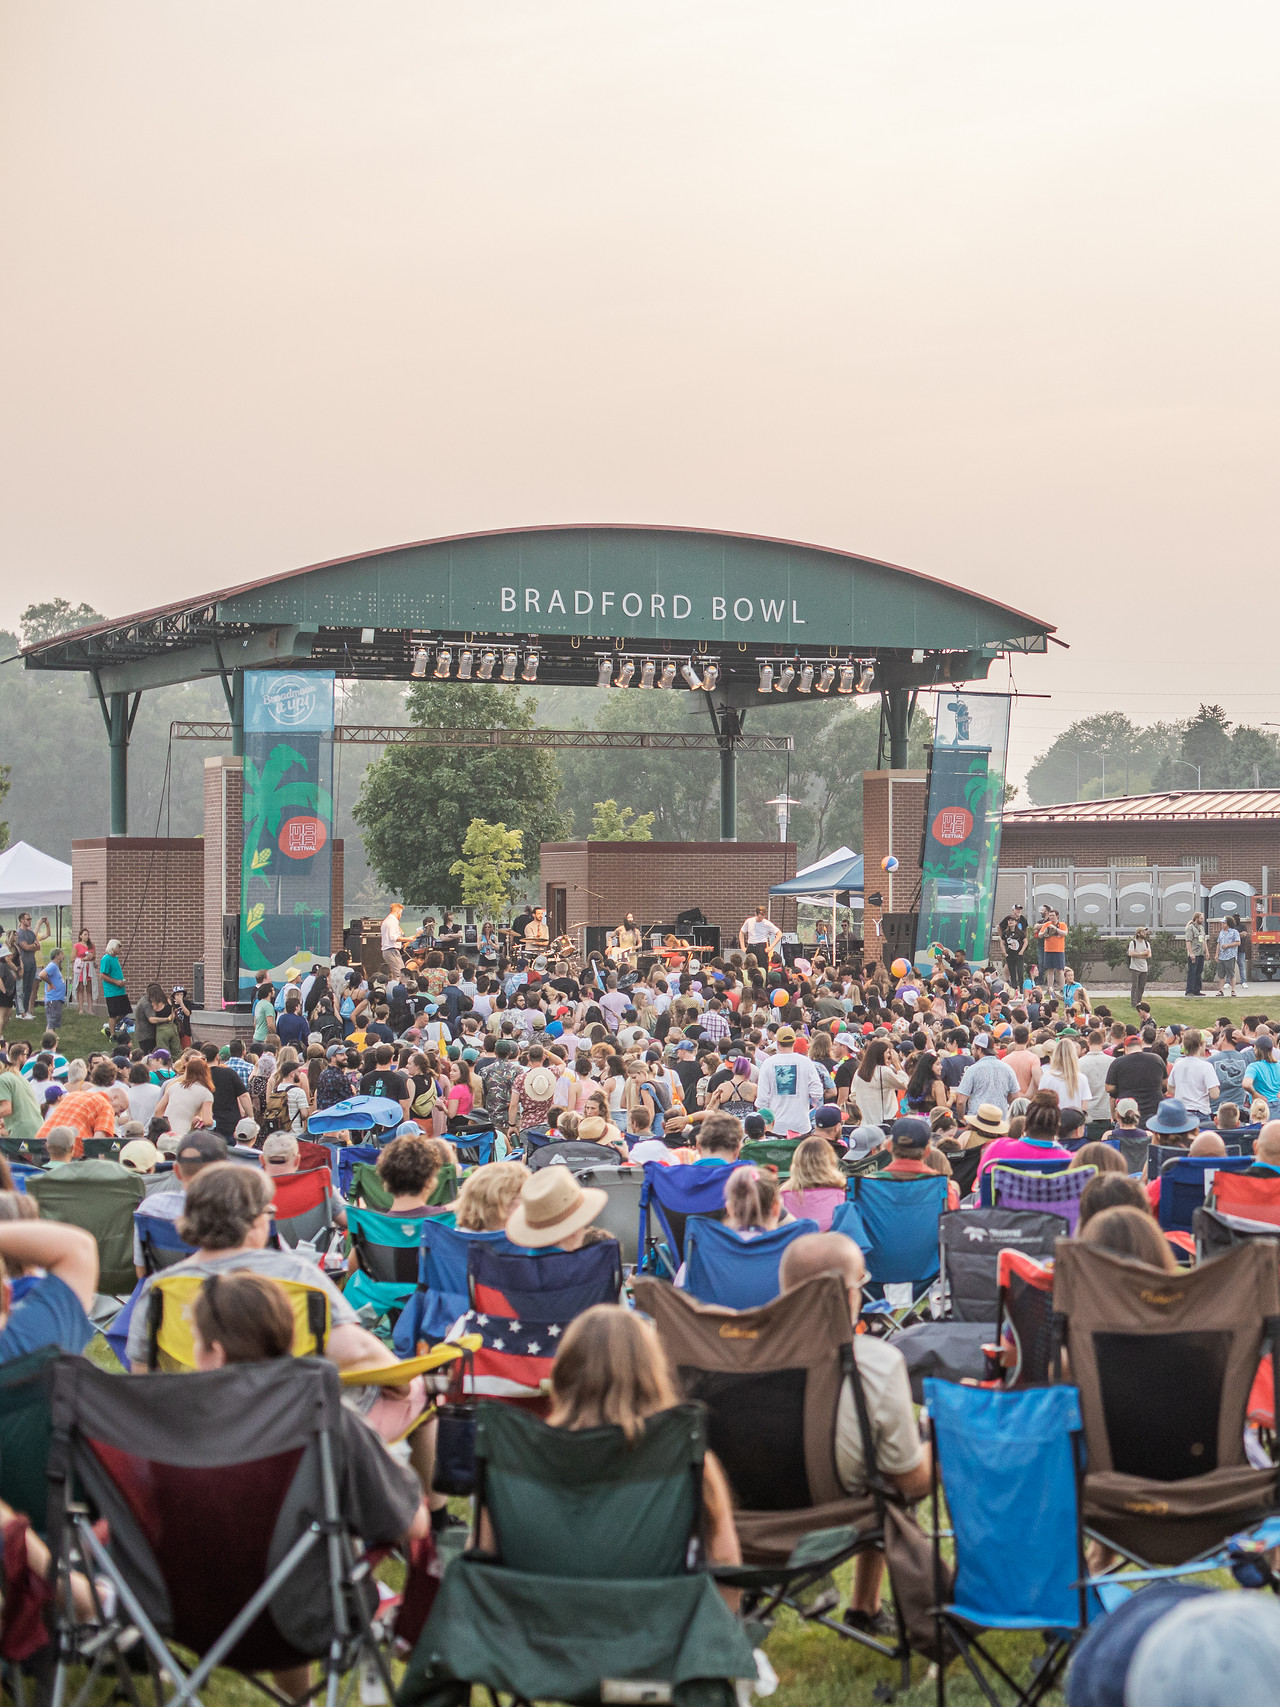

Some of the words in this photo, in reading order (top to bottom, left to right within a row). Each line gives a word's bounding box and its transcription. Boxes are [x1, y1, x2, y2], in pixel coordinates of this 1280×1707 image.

[501, 587, 692, 619] BRADFORD
[712, 596, 806, 624] BOWL
[263, 686, 317, 705] Broadmoor
